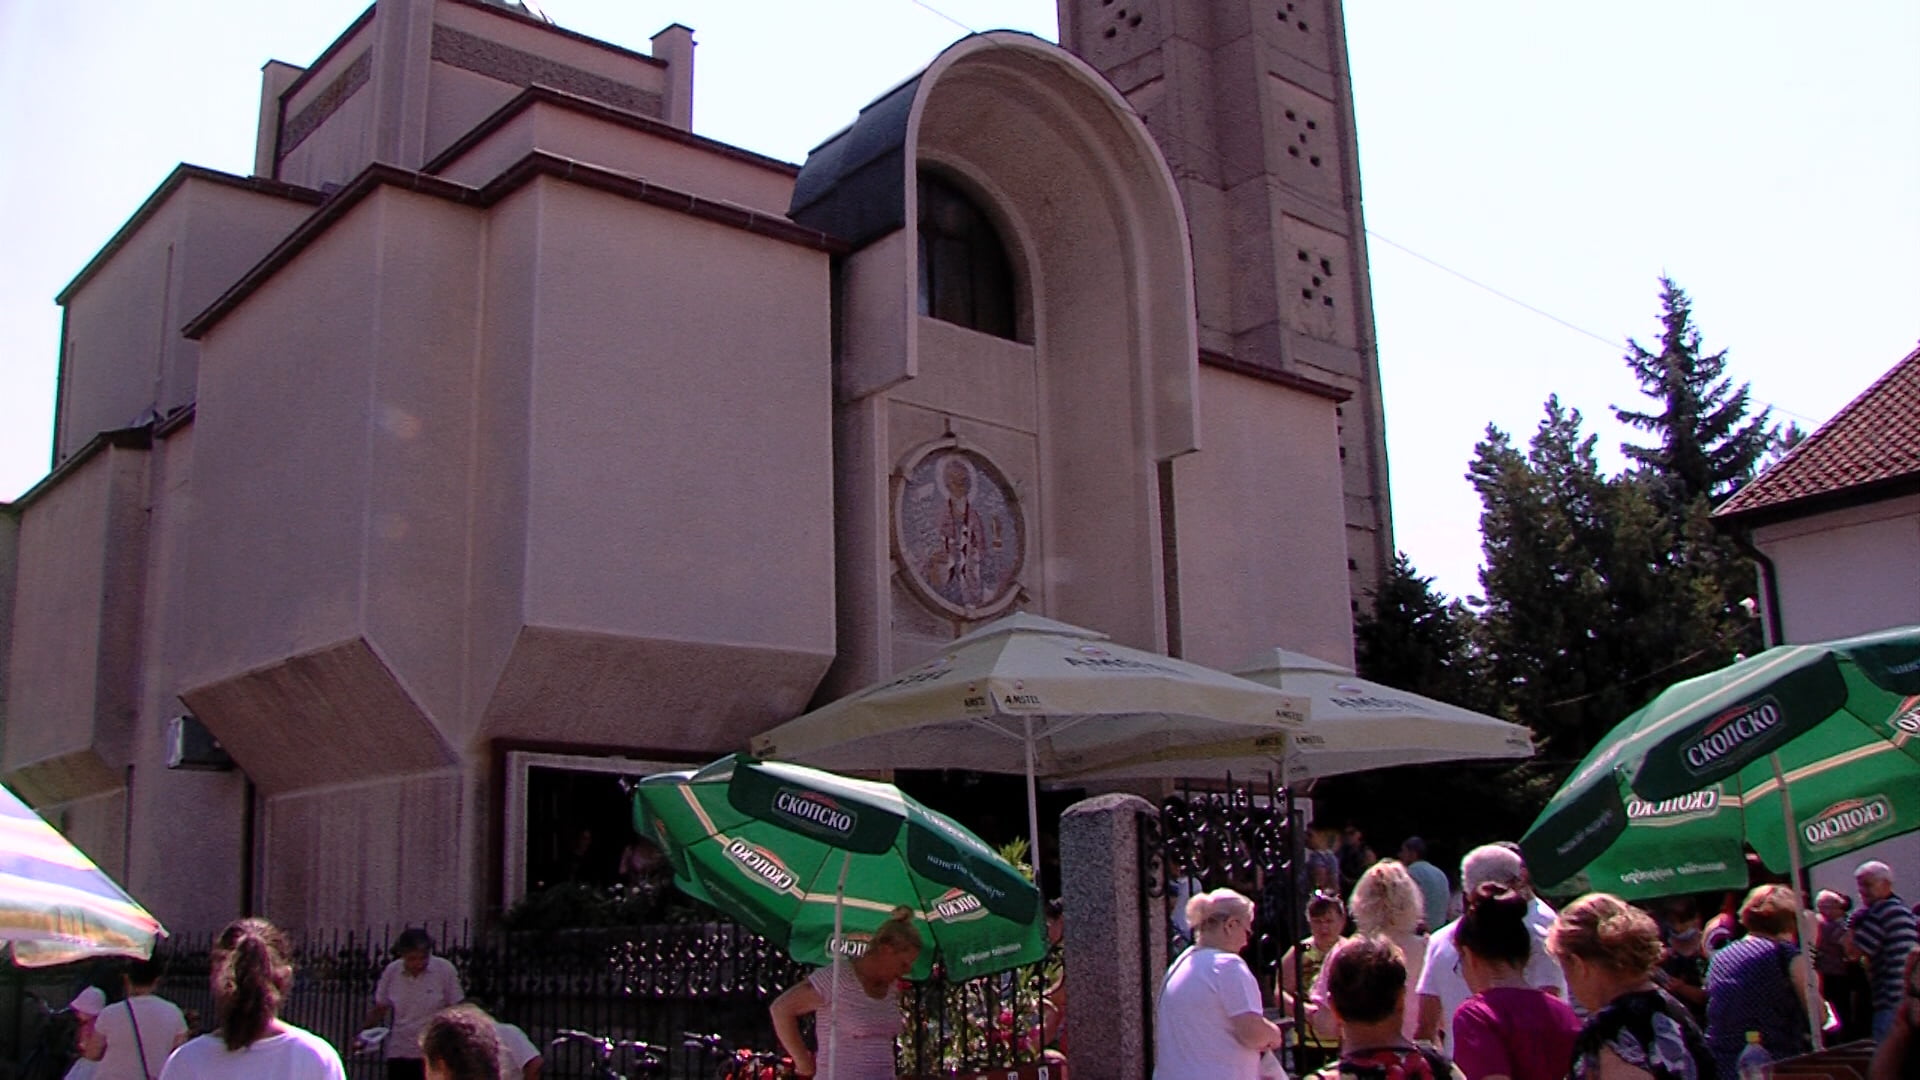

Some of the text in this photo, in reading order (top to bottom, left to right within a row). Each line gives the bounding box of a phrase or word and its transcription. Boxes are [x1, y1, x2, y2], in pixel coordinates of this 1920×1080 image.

[1004, 695, 1041, 704] AMSTEL
[1687, 704, 1777, 767] СКОПСКО
[778, 791, 851, 832] СКОПСКО
